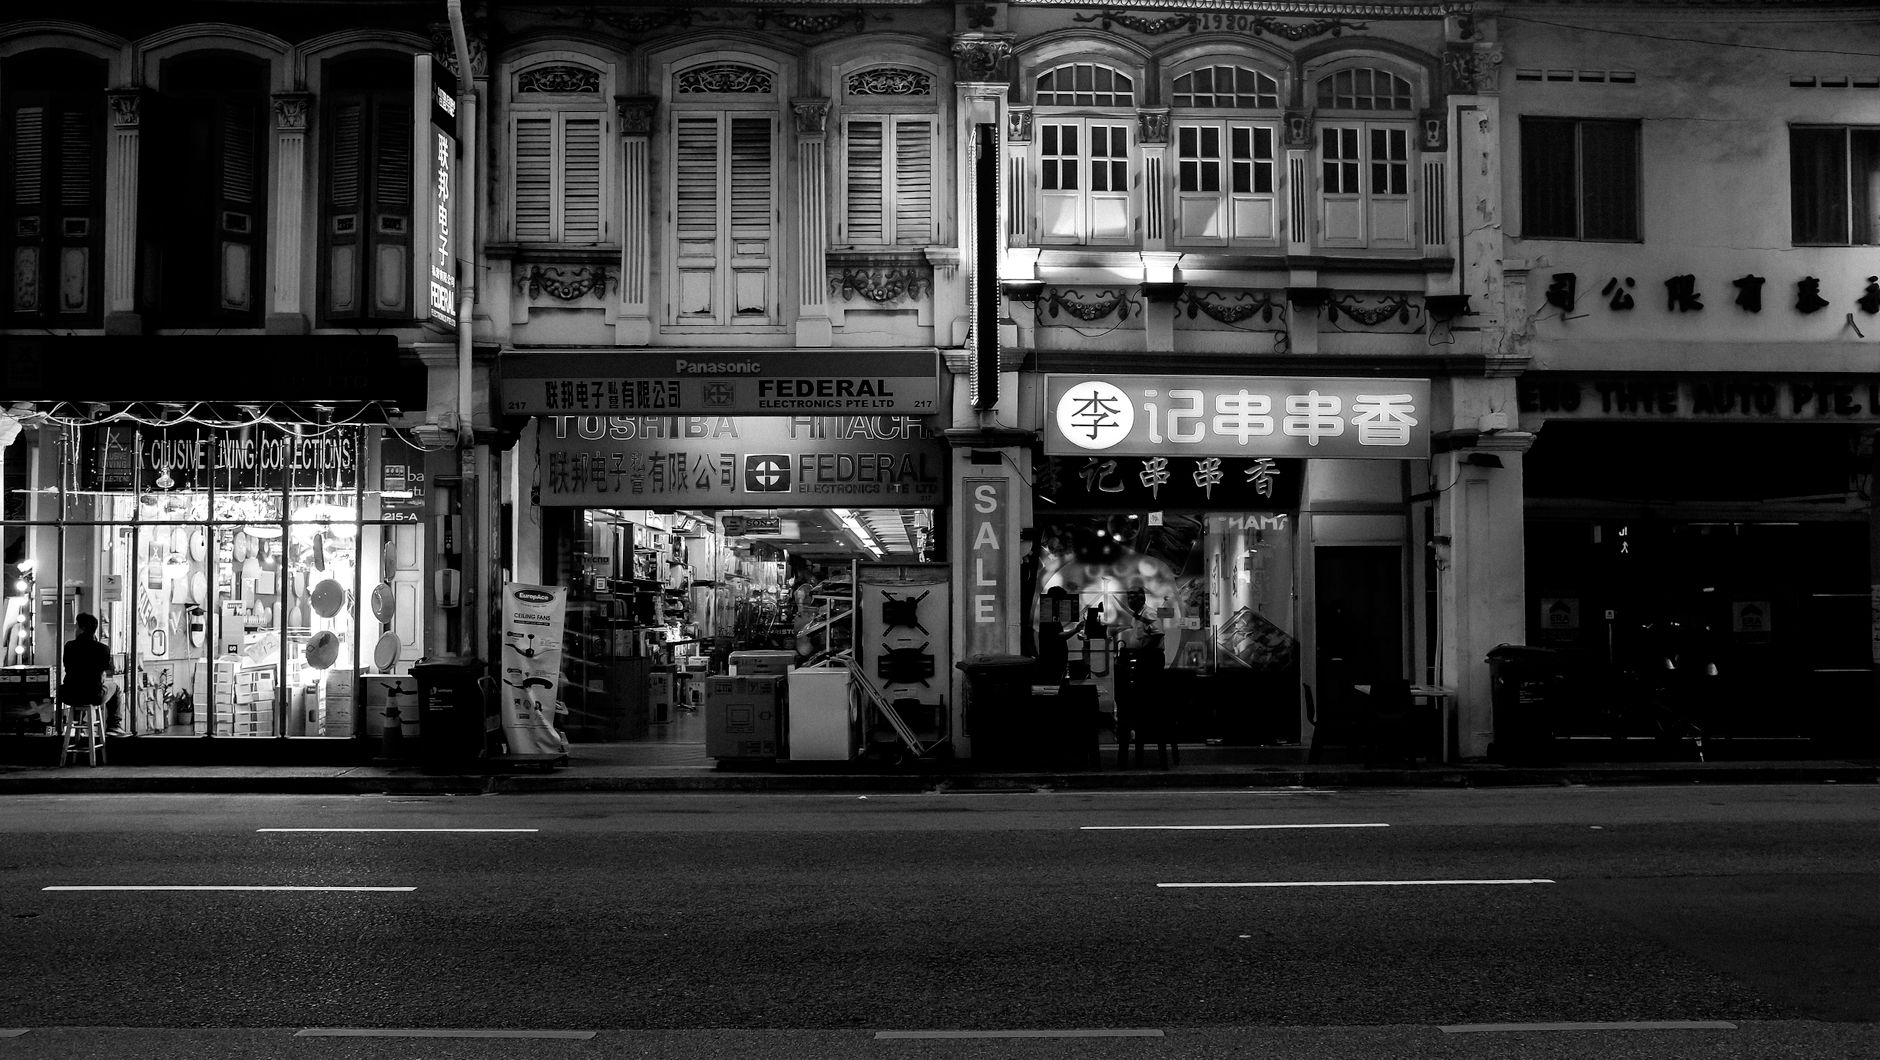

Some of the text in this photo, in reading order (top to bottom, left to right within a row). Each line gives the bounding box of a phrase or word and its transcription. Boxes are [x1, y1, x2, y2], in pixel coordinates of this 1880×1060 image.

[676, 359, 761, 374] Panasonic
[758, 380, 894, 397] FEDERAL
[508, 402, 527, 410] 217
[759, 400, 895, 408] ELECTRONICS PTE LTD
[1070, 389, 1418, 447] 李记串串香
[547, 415, 934, 440] TOSHIBA HITACH
[214, 439, 254, 470] IVING
[261, 438, 351, 470] COLECTIONS
[407, 465, 425, 482] ba
[798, 452, 938, 483] FEDERAL
[798, 483, 881, 494] ELECTRONICS
[886, 483, 910, 494] PTE
[384, 512, 418, 521] 215-A
[973, 484, 1000, 623] SALE
[513, 612, 536, 620] CEILING
